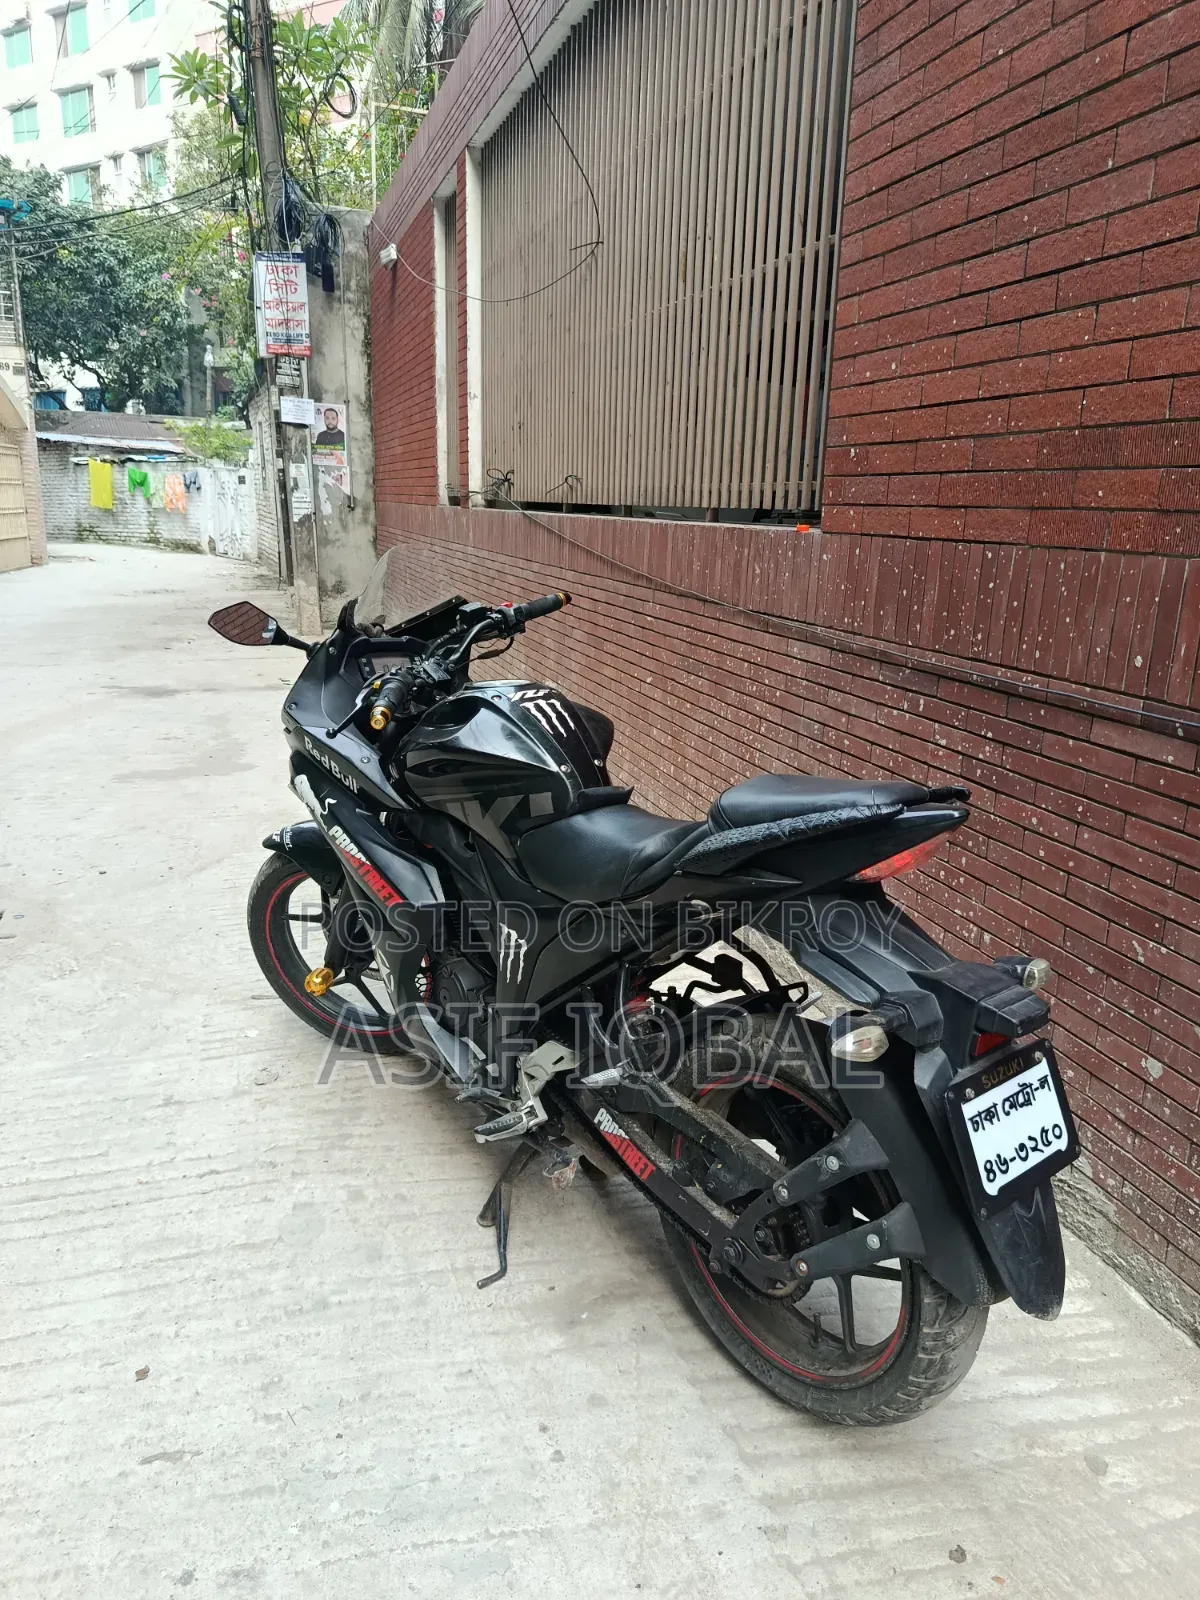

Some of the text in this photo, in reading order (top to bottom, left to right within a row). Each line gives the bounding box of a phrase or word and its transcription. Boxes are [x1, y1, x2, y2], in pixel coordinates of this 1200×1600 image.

[264, 264, 299, 278] ঢাকা
[267, 279, 299, 295] সিটি
[304, 735, 359, 795] Red Bull
[981, 1057, 1024, 1089] SUZUKI
[968, 1102, 1001, 1132] ঢাকা
[983, 1123, 1063, 1183] ৪৬-৩২৫০
